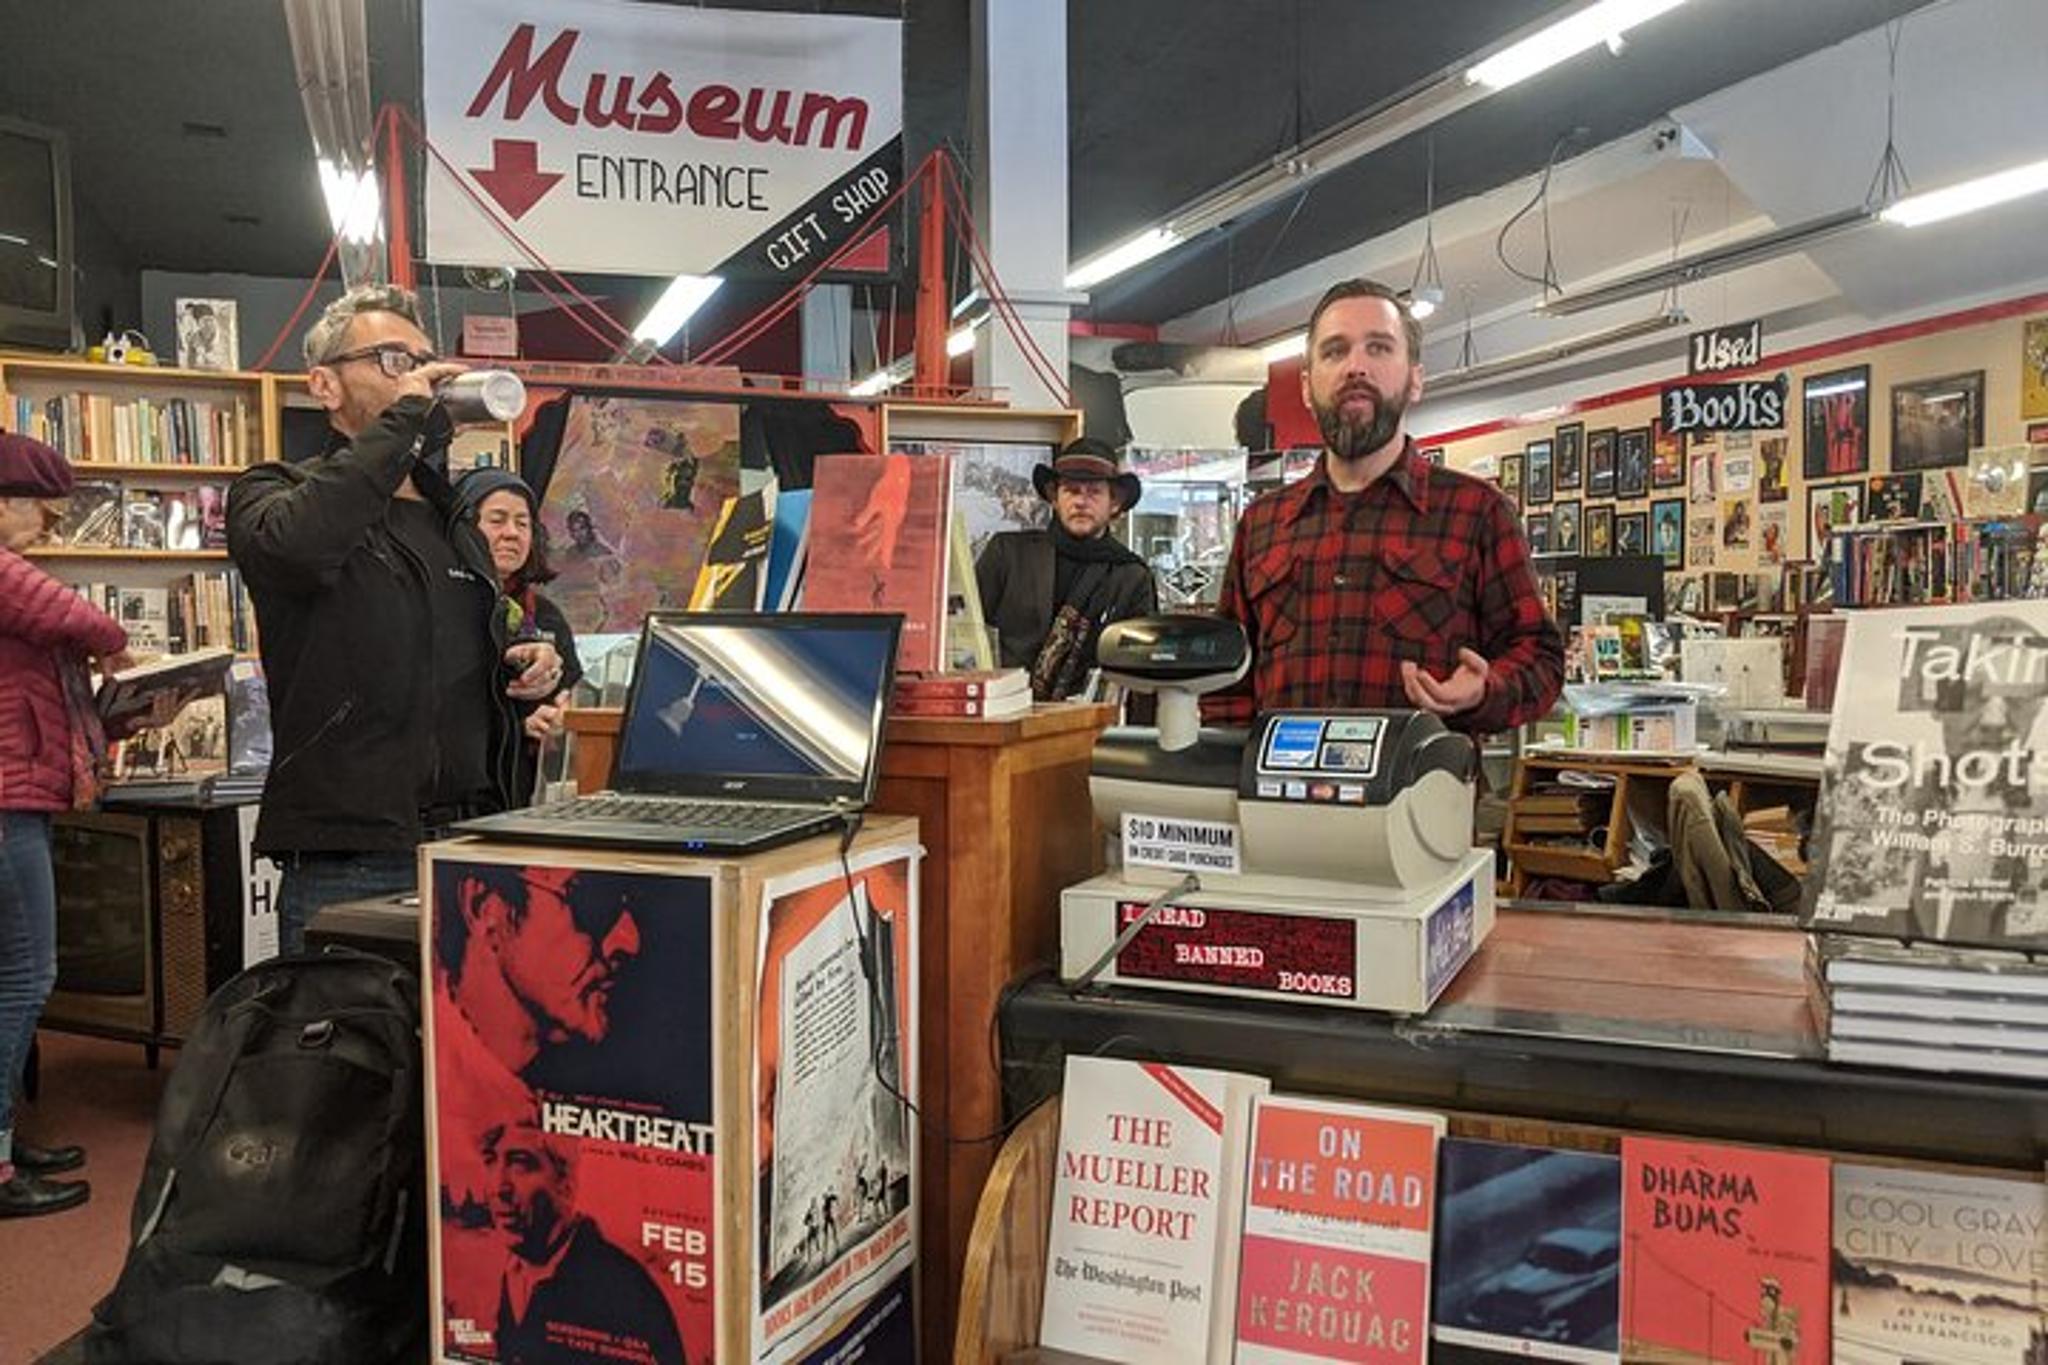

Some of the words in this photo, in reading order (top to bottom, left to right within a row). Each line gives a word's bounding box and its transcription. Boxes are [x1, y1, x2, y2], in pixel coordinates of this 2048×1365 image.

[466, 23, 869, 151] Museum
[577, 153, 769, 210] ENTRANCE
[767, 213, 829, 271] GIFT
[832, 168, 890, 223] SHOP
[1695, 322, 1758, 371] Used
[1669, 384, 1780, 432] Books
[1129, 818, 1155, 840] $10
[1158, 822, 1232, 848] MINIMUM
[1876, 806, 1916, 826] The
[1871, 829, 1950, 850] William
[1175, 944, 1264, 967] BANNED
[1278, 972, 1352, 996] BOOKS
[542, 1102, 714, 1156] HEARTBEAT
[1108, 1113, 1172, 1148] THE
[1318, 1125, 1362, 1161] ON
[1063, 1152, 1211, 1199] MUELLER
[1258, 1157, 1317, 1195] THE
[1334, 1167, 1422, 1208] ROAD
[1641, 1163, 1758, 1204] DHARMA
[1069, 1194, 1197, 1241] REPORT
[1653, 1200, 1742, 1239] BUMS
[1845, 1192, 1942, 1230] COOL
[1953, 1206, 2046, 1238] GRAY
[642, 1221, 707, 1256] FEB
[1846, 1227, 1921, 1258] CITY
[1956, 1241, 2048, 1275] LOVE
[669, 1259, 707, 1289] 15
[1055, 1256, 1078, 1280] The
[1083, 1260, 1166, 1296] Washington
[1169, 1280, 1201, 1303] Post
[1289, 1257, 1374, 1305] JACK
[1250, 1294, 1410, 1353] KEROUAC
[1882, 1320, 1913, 1334] SAN
[1917, 1323, 2014, 1347] FRANCISCO
[1923, 1311, 1973, 1325] VIEWS
